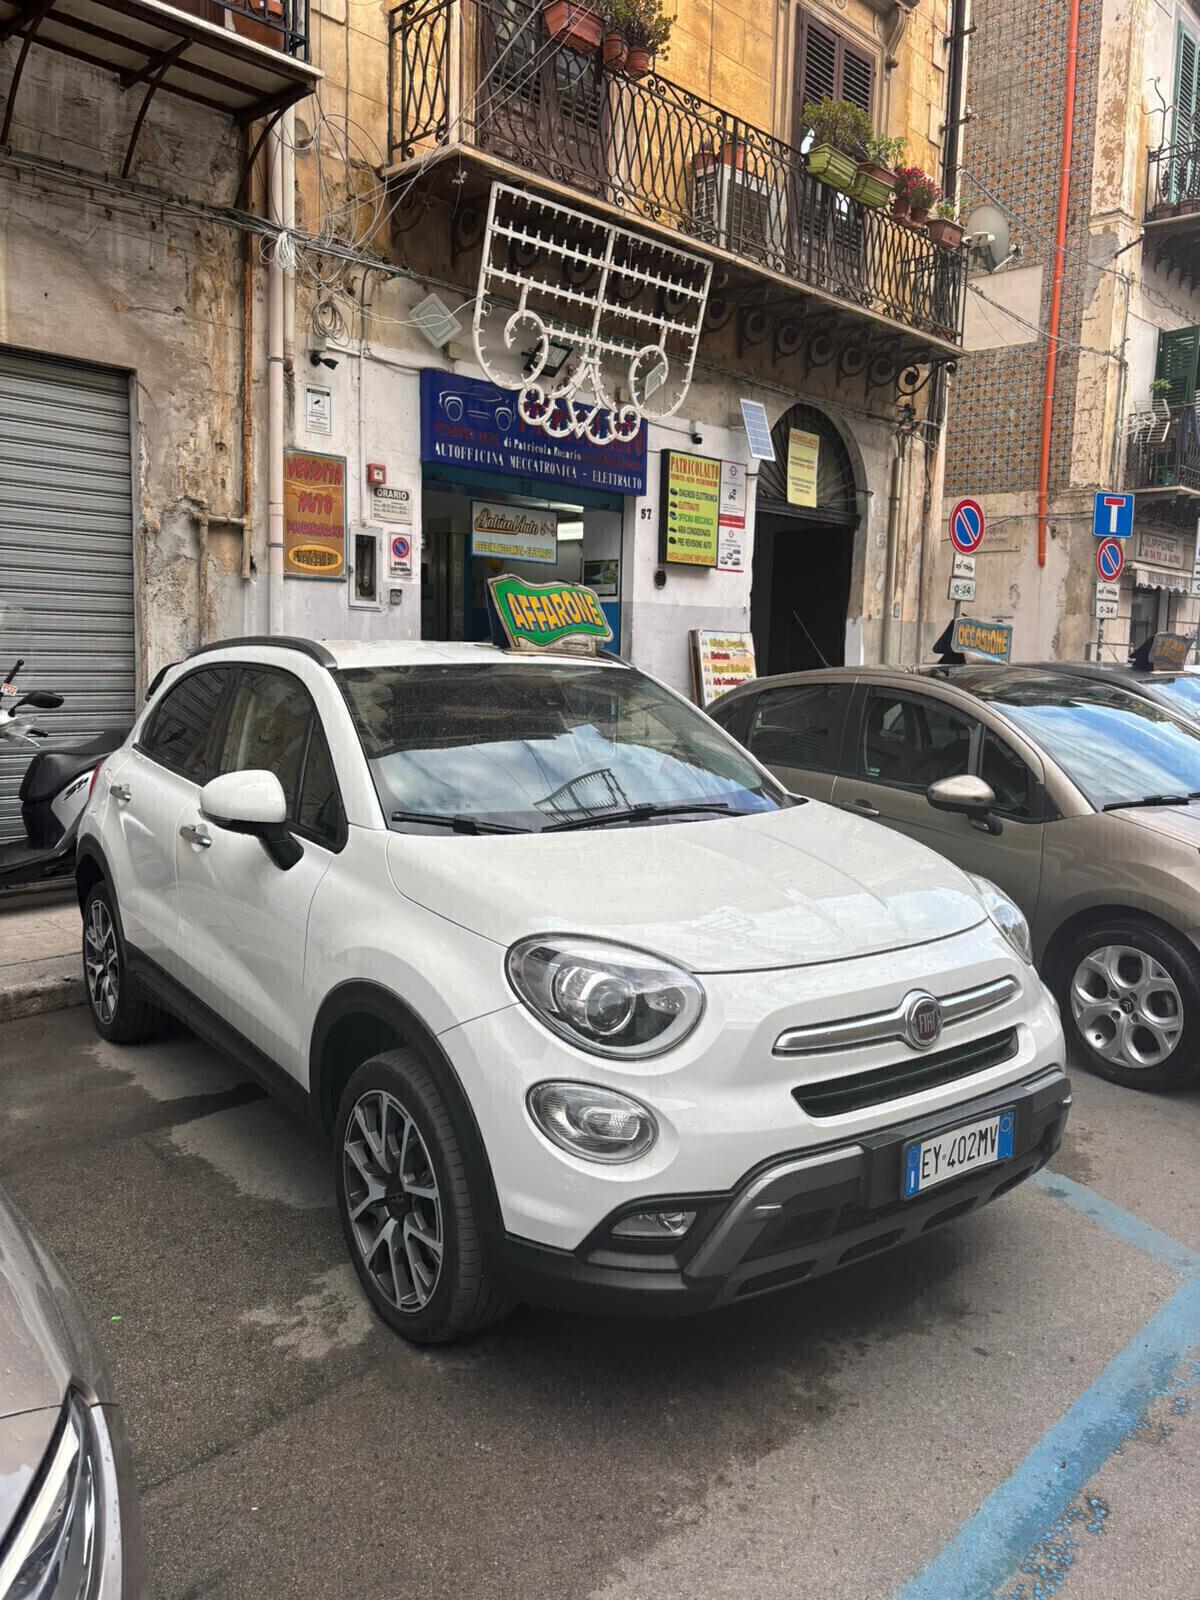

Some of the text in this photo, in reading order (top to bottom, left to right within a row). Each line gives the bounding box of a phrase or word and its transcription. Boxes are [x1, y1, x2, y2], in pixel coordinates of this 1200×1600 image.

[503, 436, 512, 448] di
[513, 438, 552, 455] Patricola
[553, 446, 582, 461] Rosario
[288, 457, 343, 485] VENDITA
[435, 441, 504, 467] AUTOFFICINA
[509, 455, 577, 479] MECCATRONICA
[592, 469, 642, 490] ELETTRAUTO
[670, 455, 720, 480] PATRICOLAUTO
[298, 490, 333, 515] AUTO
[376, 488, 407, 501] ORARIO
[640, 508, 652, 520] 57
[954, 585, 971, 595] 0-24
[506, 590, 604, 633] AFFARONE
[1100, 606, 1114, 614] 0-24
[958, 623, 1008, 655] OCCASIONE
[918, 1008, 937, 1034] FIAT
[921, 1123, 999, 1180] EY 402MV
